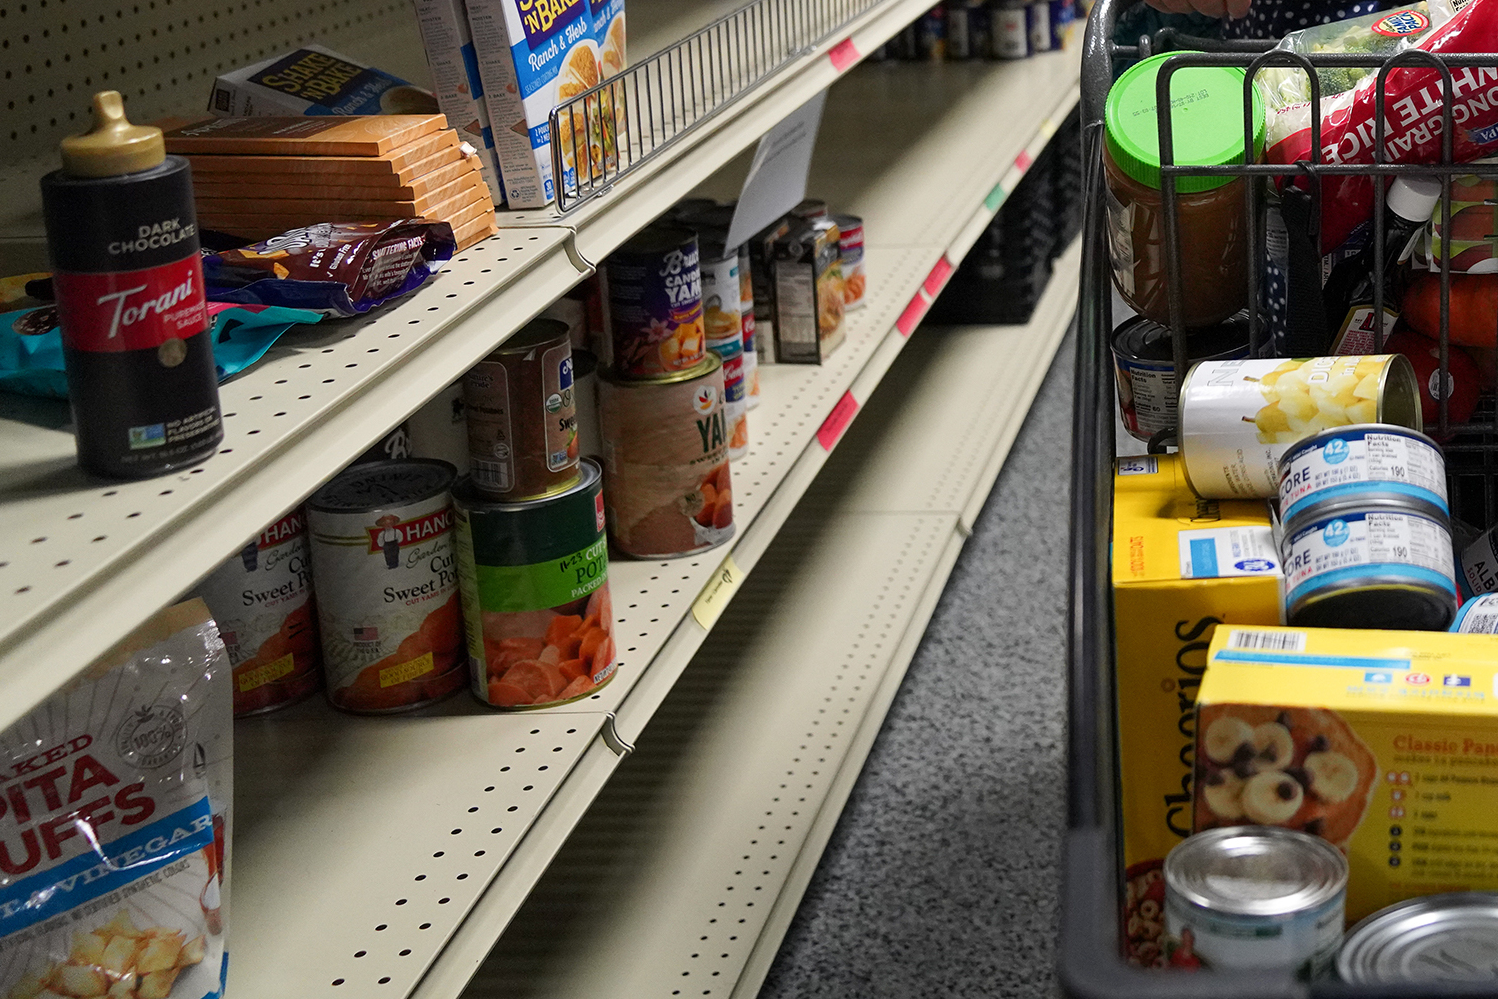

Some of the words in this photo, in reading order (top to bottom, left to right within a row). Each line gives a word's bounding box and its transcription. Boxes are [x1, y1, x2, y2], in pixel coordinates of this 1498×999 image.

[525, 6, 540, 35] 'N
[528, 44, 559, 72] Ranch
[565, 21, 588, 47] Herb
[262, 53, 337, 92] SHAKE
[310, 63, 362, 96] BAKE
[332, 94, 362, 116] Ranch
[1322, 113, 1394, 164] RICE
[109, 224, 196, 254] CHOCOLATE
[139, 217, 180, 238] DARK
[341, 244, 352, 258] Free
[97, 270, 194, 339] Torani
[1281, 466, 1311, 500] CORE
[1391, 465, 1405, 478] 190
[1290, 483, 1312, 500] TUNA
[1393, 546, 1408, 558] 190
[571, 578, 600, 598] PACKED
[1292, 566, 1313, 582] TUNA
[1474, 561, 1495, 591] ALB
[242, 582, 293, 607] Sweet
[383, 579, 434, 603] Sweet
[1161, 615, 1224, 838] Cheerios
[1393, 734, 1457, 753] Classic
[0, 754, 120, 825] ITA
[0, 782, 156, 875] UFFS
[56, 814, 213, 891] VINEGAR
